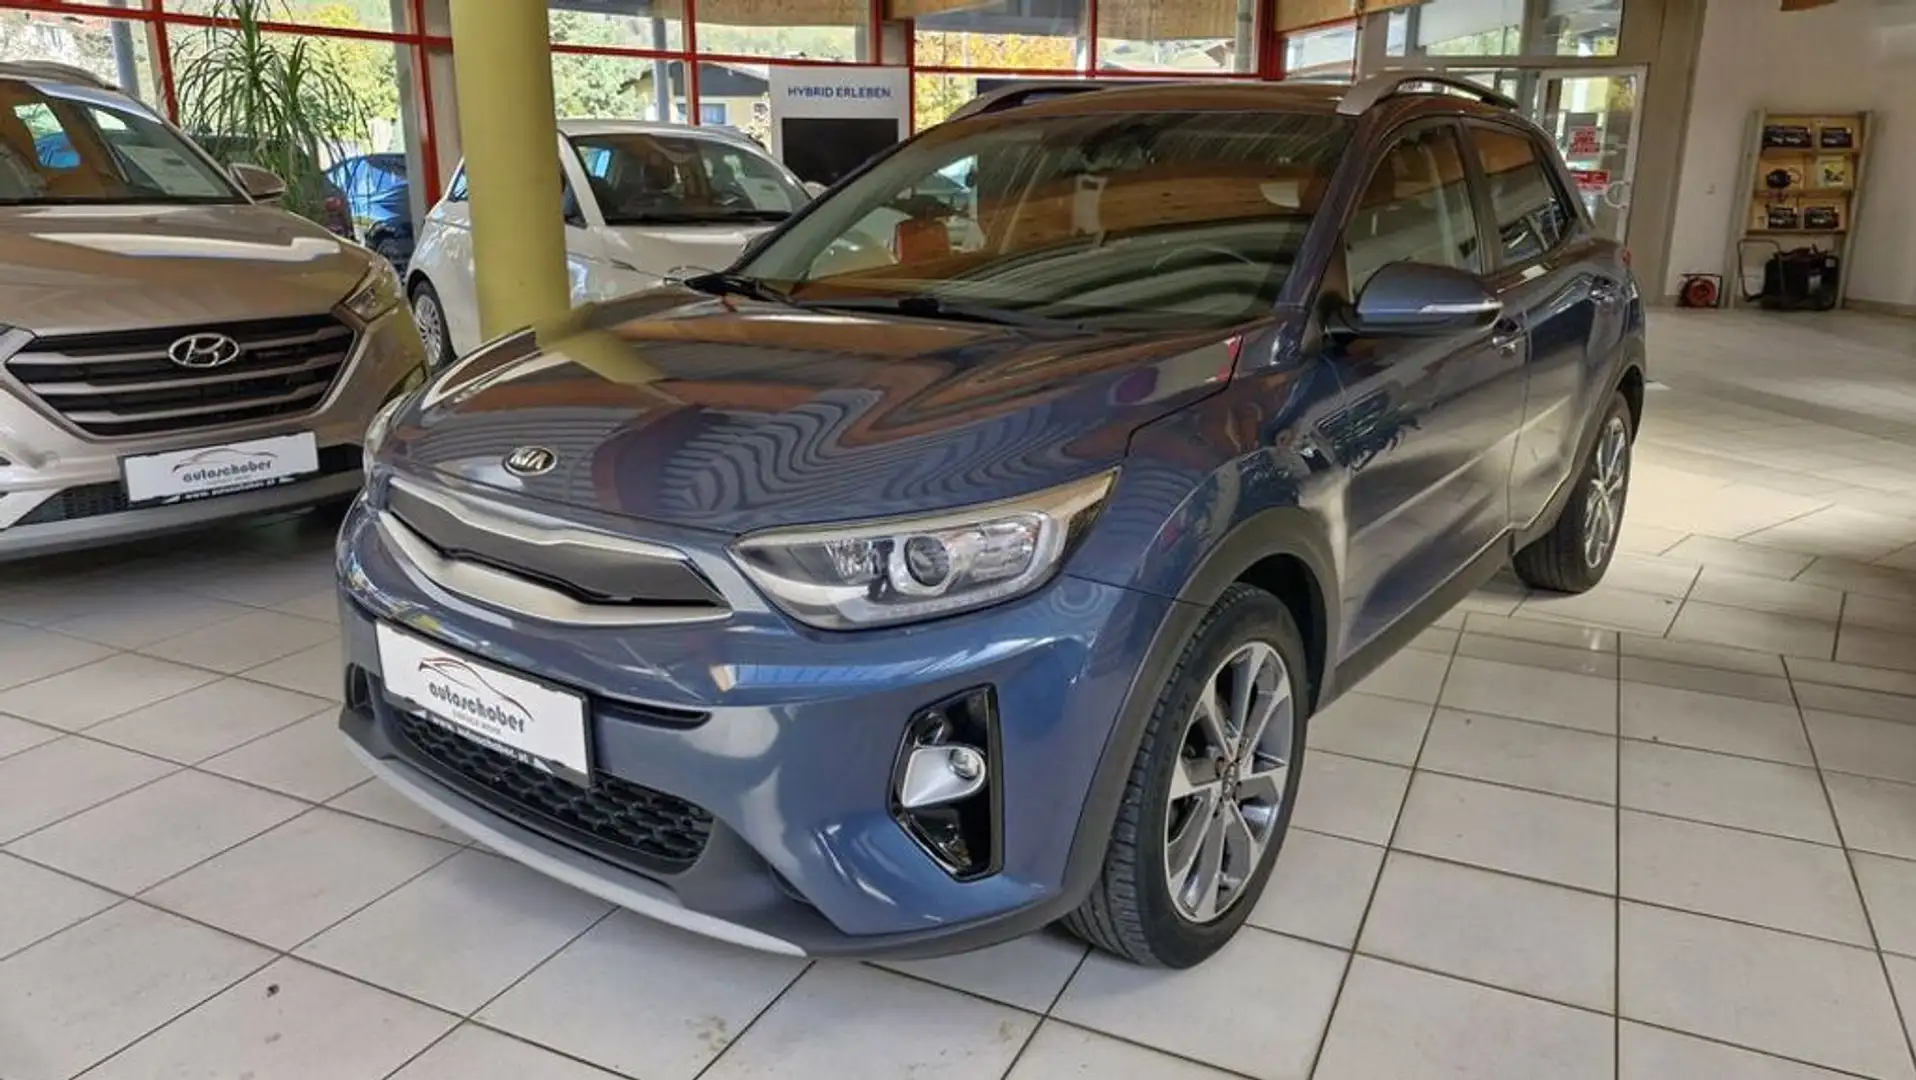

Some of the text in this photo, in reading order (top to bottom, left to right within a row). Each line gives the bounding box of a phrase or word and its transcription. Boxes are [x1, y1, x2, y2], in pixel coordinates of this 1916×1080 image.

[787, 86, 891, 99] HYBRID ERLEBEN
[182, 459, 272, 483] autoschober
[428, 680, 525, 733] autoschober
